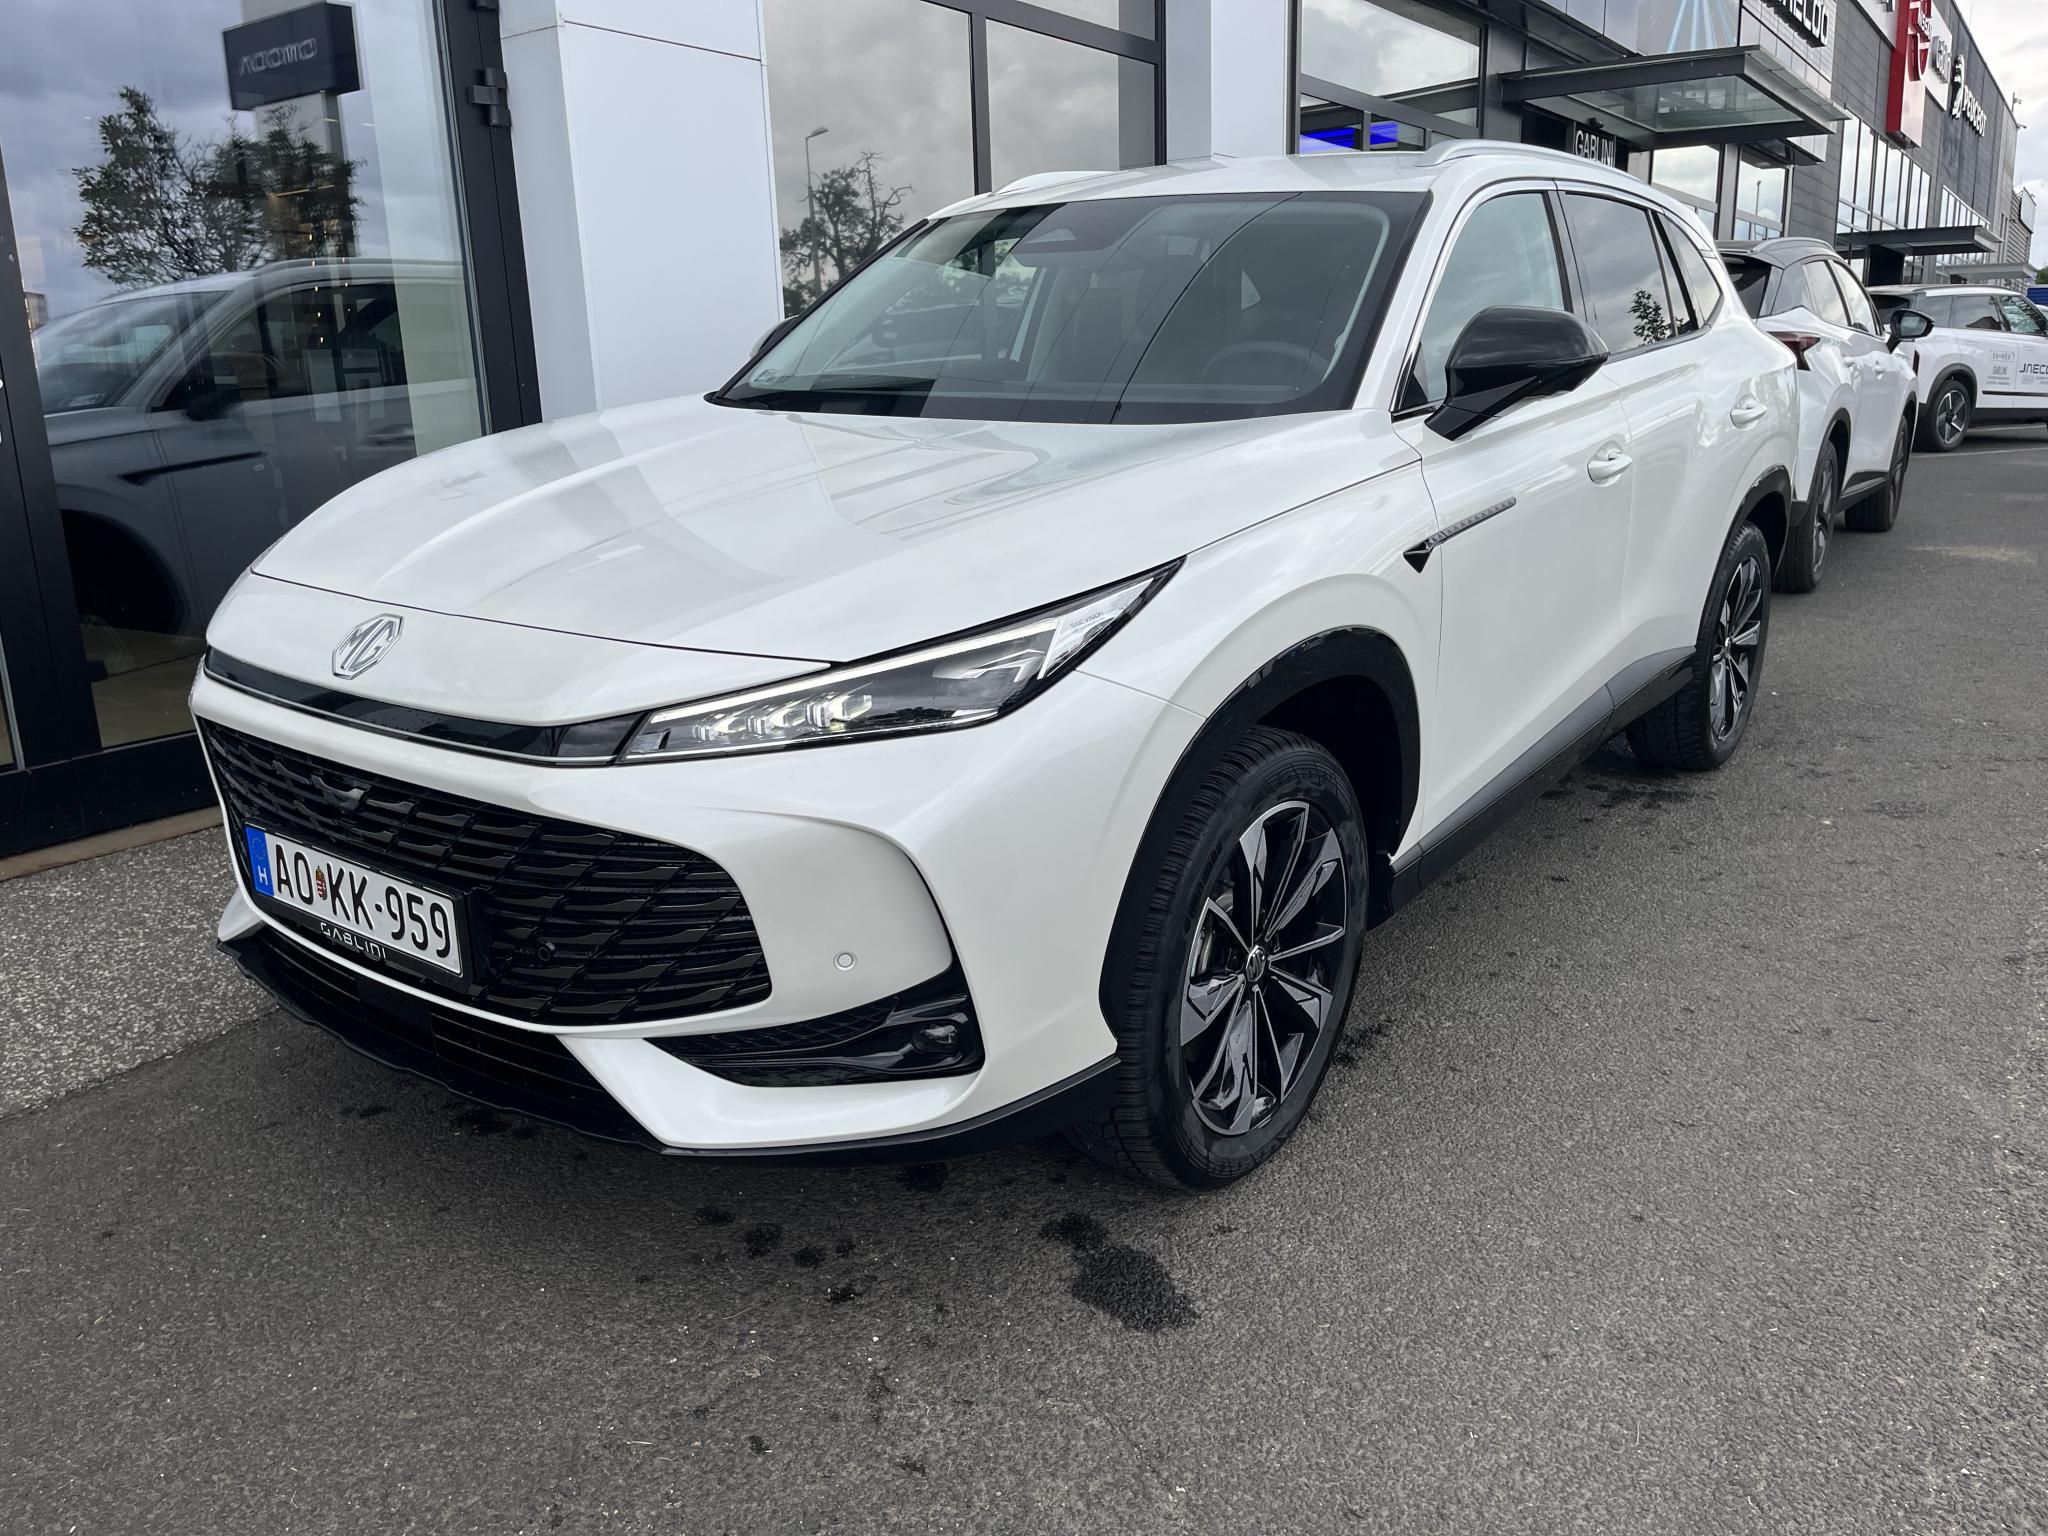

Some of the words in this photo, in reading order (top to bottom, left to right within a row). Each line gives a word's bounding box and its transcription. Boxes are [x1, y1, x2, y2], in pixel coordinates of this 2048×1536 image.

[337, 617, 397, 673] MG
[258, 865, 268, 886] H
[320, 921, 387, 959] GABLINI
